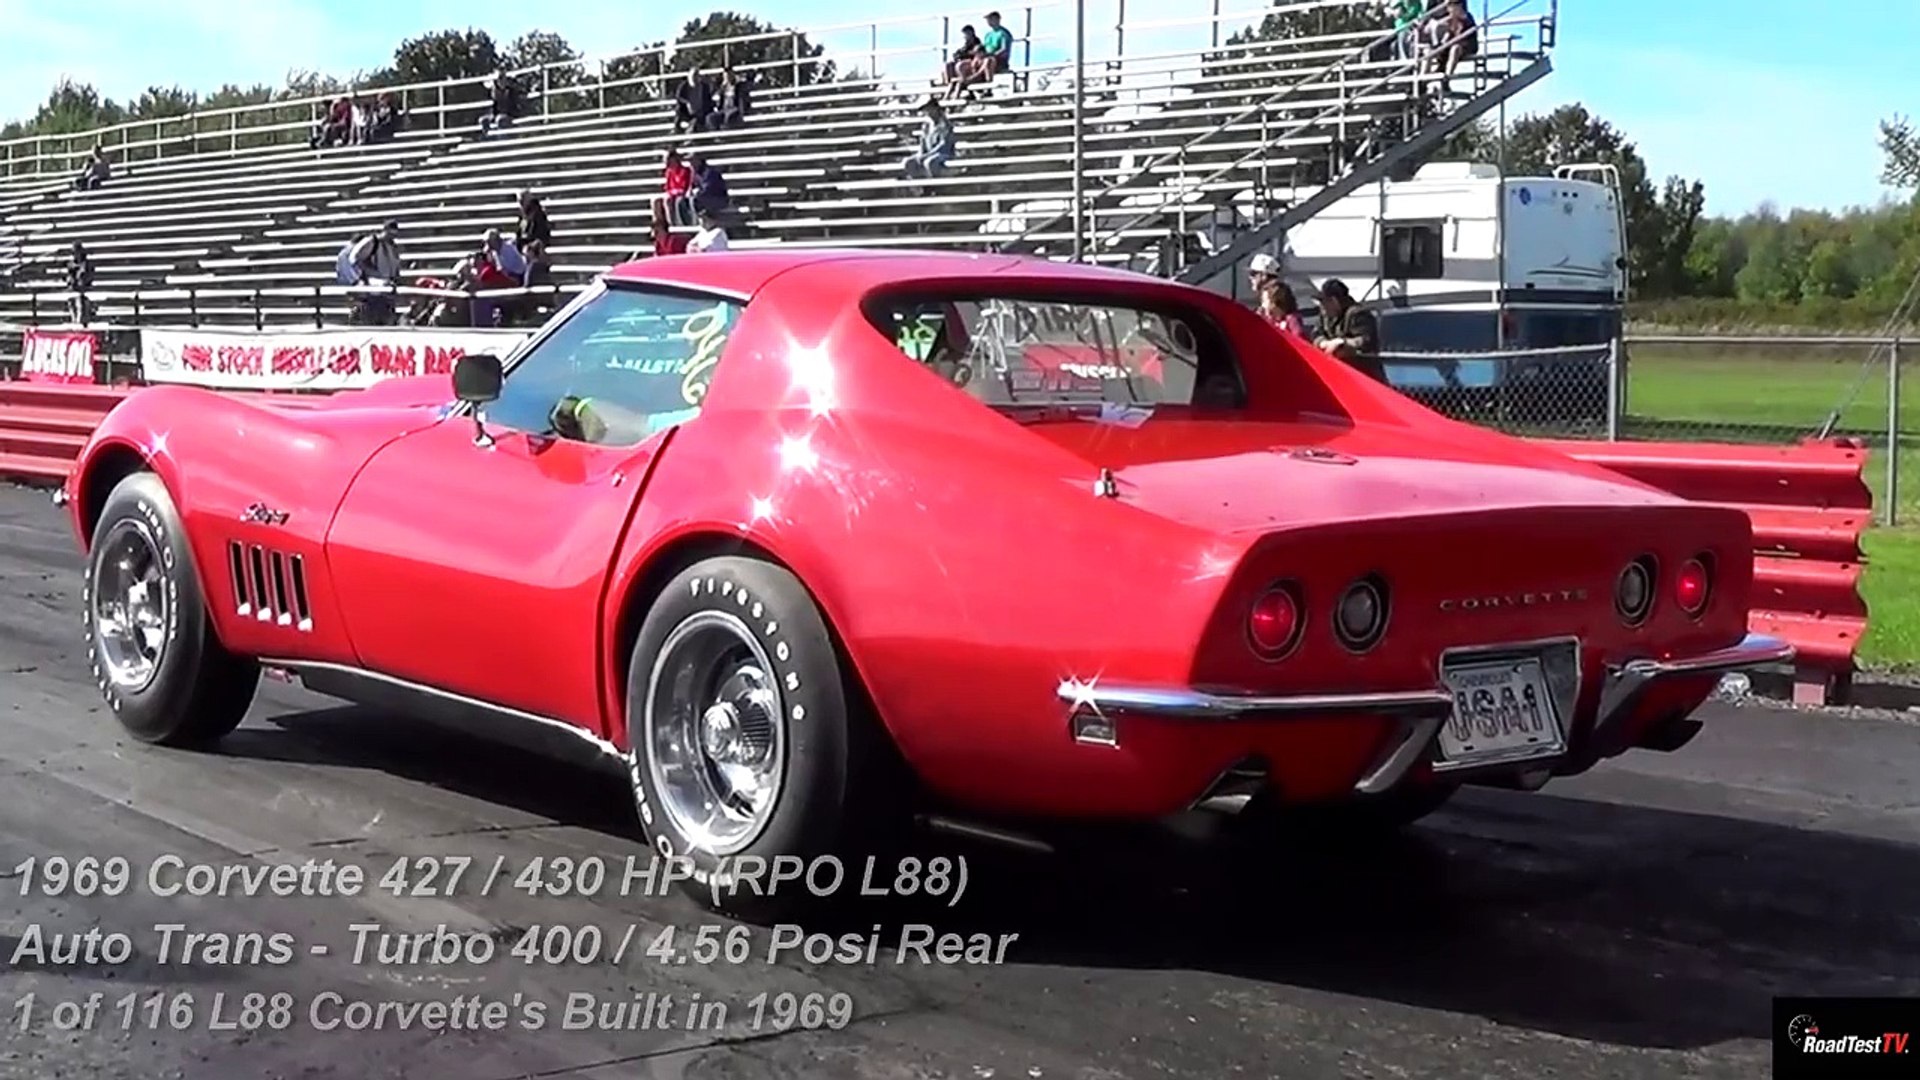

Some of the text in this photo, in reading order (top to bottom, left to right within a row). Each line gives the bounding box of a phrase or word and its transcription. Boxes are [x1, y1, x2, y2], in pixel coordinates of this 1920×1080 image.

[67, 340, 93, 377] OIL
[217, 345, 264, 376] STOCK
[370, 343, 417, 377] DRAG
[1440, 589, 1588, 610] CORVETTE
